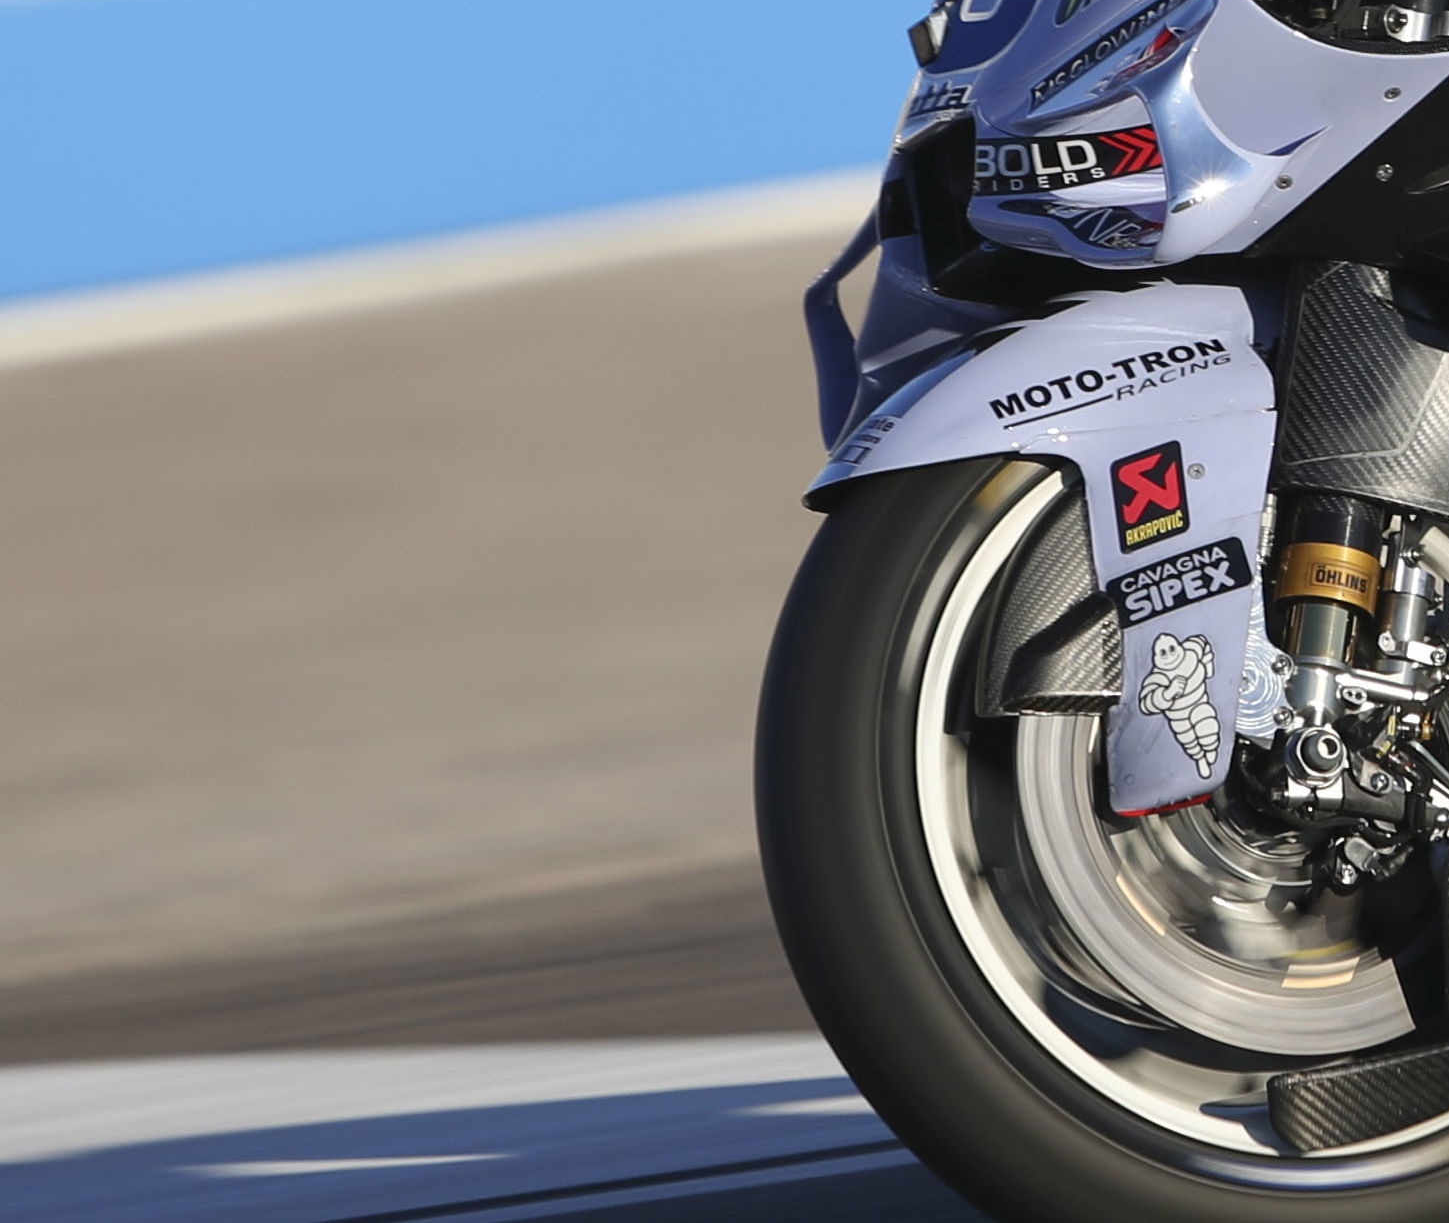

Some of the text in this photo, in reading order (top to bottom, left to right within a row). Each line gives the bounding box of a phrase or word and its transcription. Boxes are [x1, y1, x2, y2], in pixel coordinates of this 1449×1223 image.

[988, 337, 1226, 419] MOTO-TRON
[1116, 353, 1232, 402] RACING
[1119, 546, 1229, 596] CAVAGNA
[1124, 559, 1236, 626] SIPEX
[1314, 564, 1369, 597] ÖHLINS
